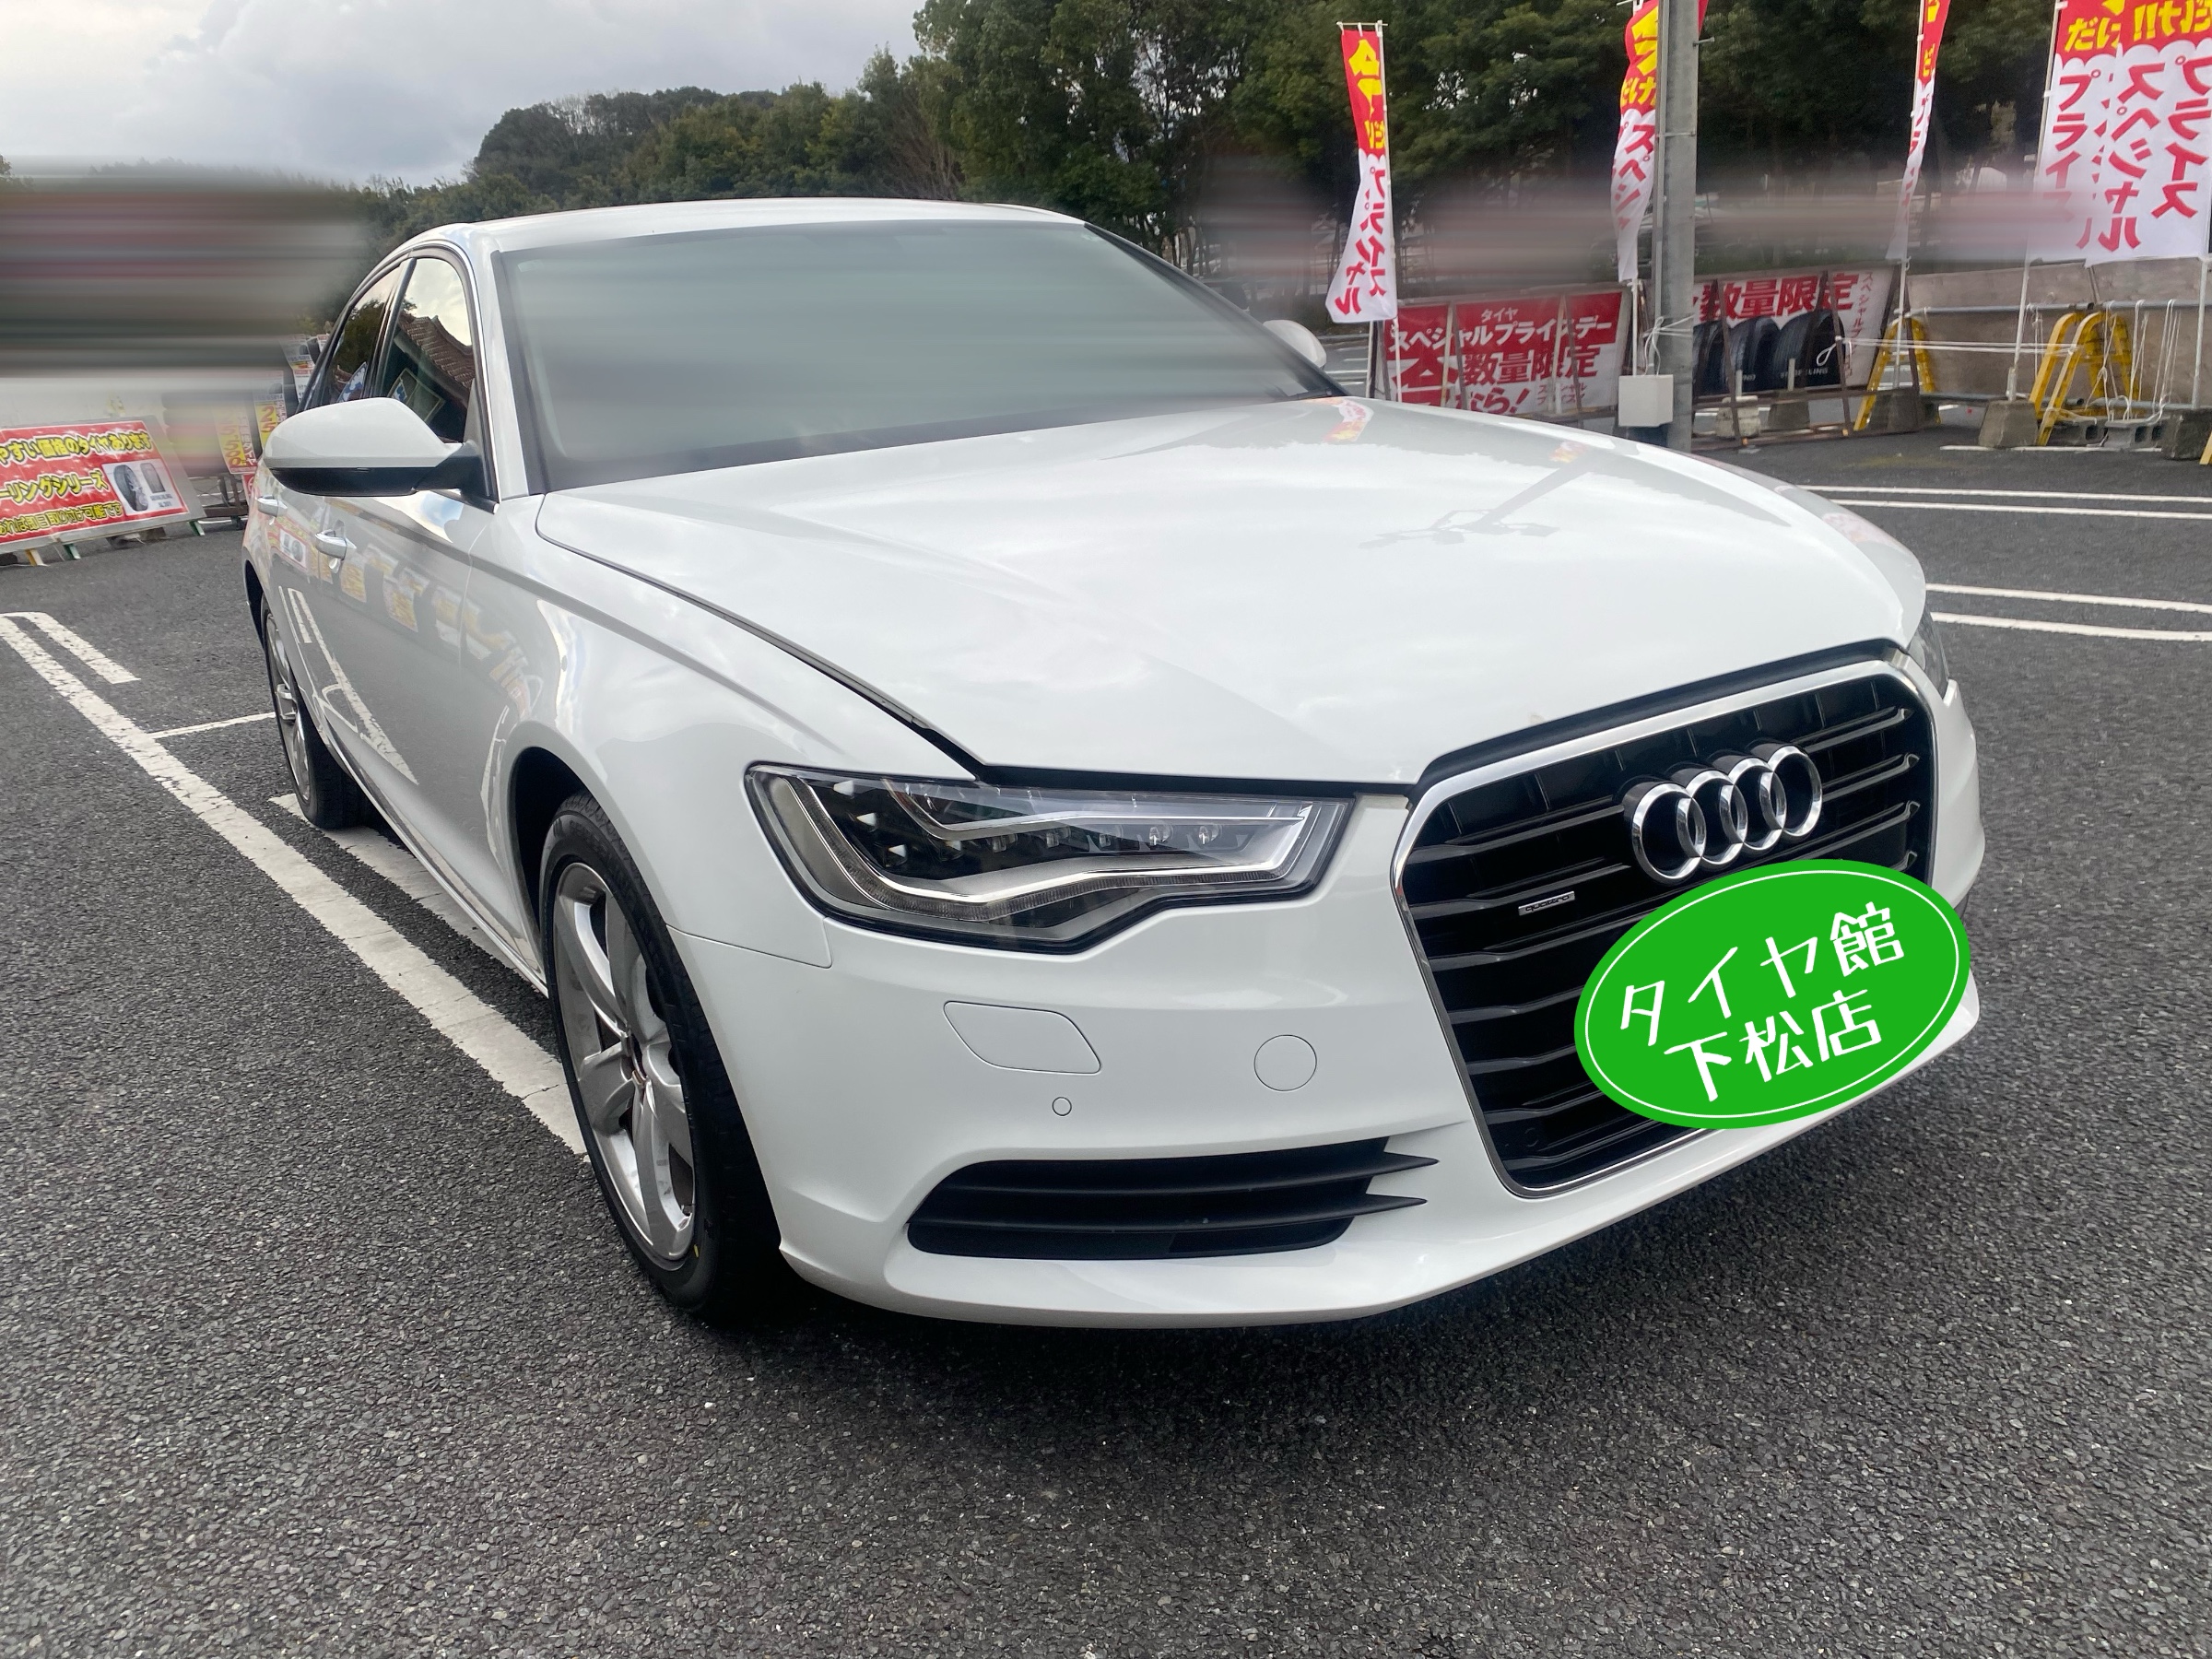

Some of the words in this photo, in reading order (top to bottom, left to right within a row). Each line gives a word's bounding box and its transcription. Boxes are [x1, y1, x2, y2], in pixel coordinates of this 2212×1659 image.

[1699, 273, 1859, 322] 数量限定
[1481, 307, 1519, 323] タイヤ
